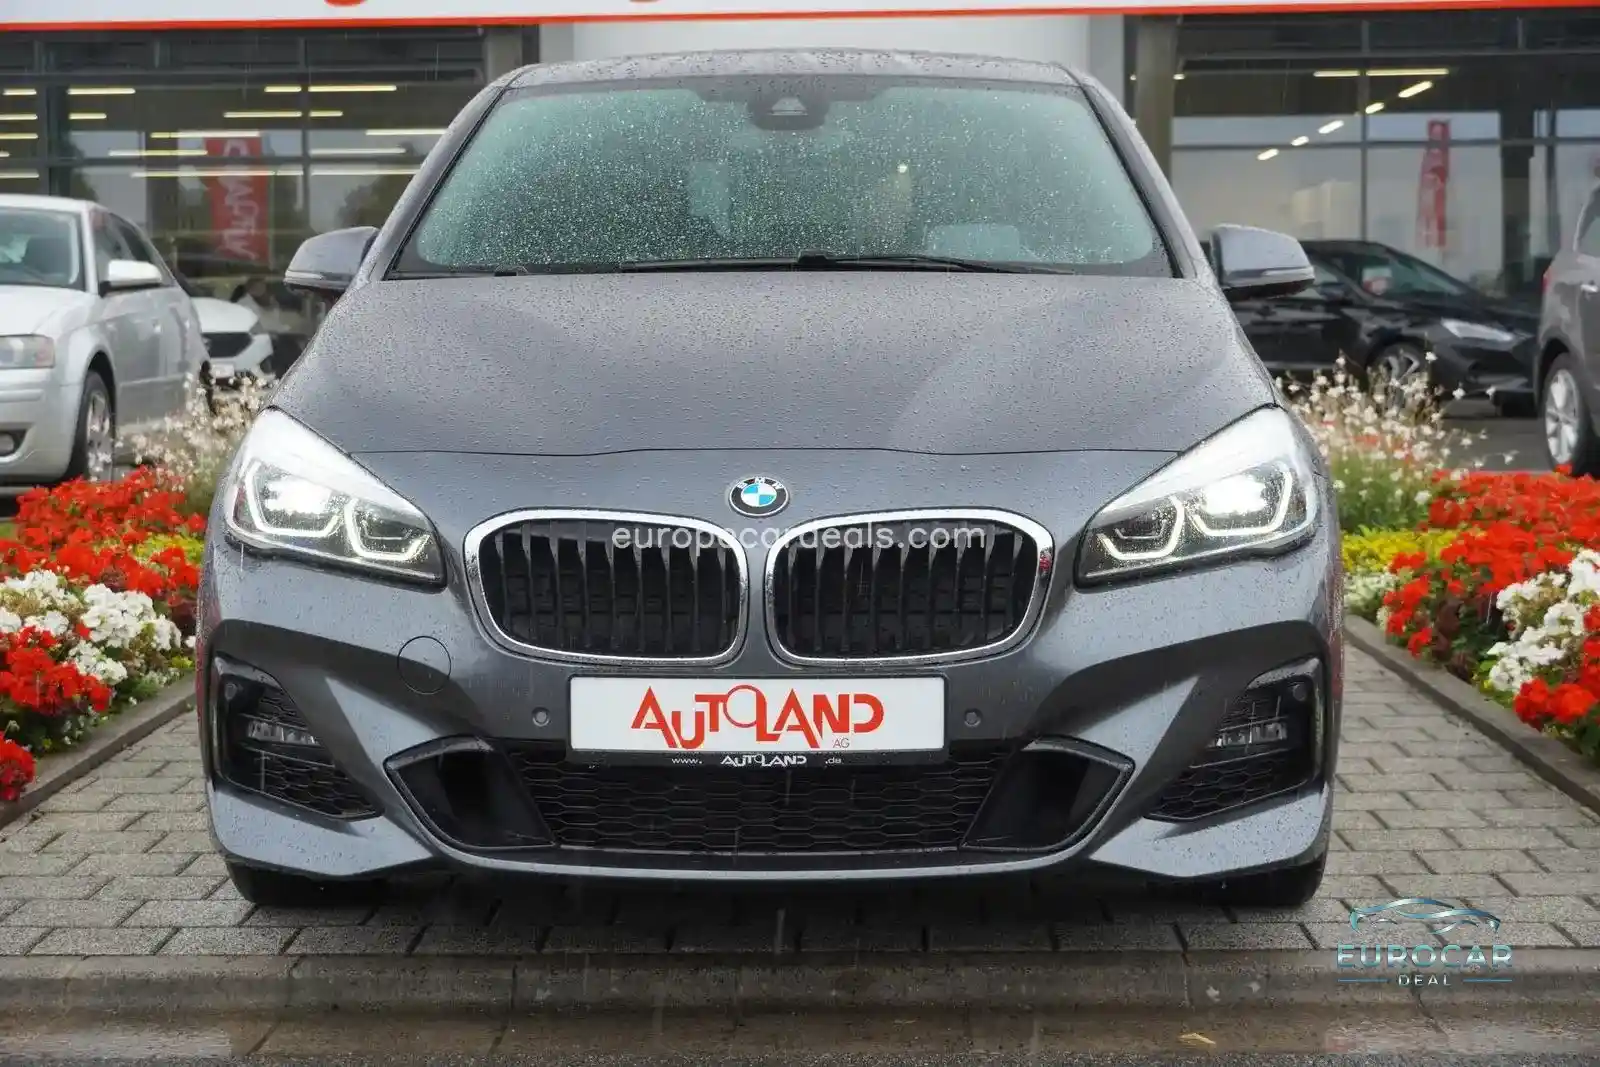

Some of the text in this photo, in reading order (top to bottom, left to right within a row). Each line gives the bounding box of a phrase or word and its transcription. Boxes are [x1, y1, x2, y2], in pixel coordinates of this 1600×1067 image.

[736, 476, 785, 490] BMW
[631, 685, 885, 750] AUTOLAND AG
[720, 754, 807, 768] AUTOLAND
